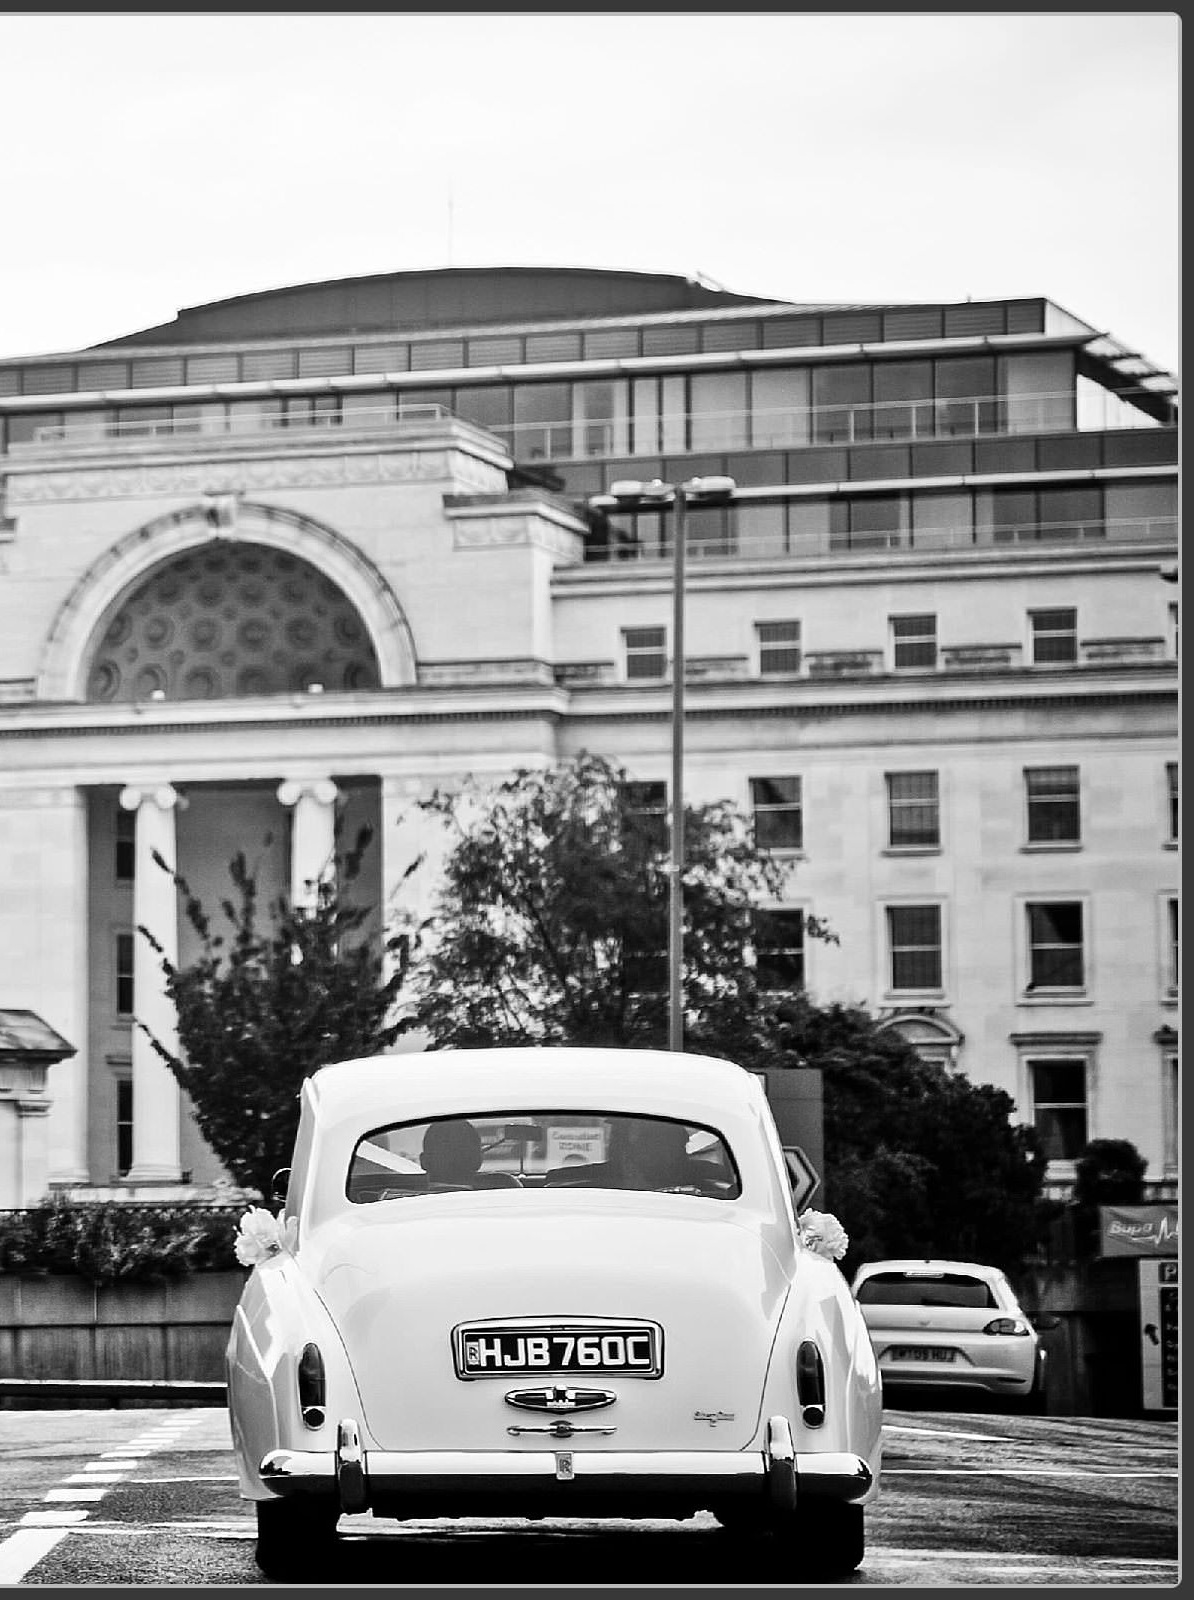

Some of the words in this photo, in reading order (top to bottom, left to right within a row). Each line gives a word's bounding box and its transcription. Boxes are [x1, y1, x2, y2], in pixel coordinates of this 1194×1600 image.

[1109, 1221, 1154, 1236] Bupa
[478, 1337, 550, 1367] HJB
[553, 1336, 650, 1366] 760C
